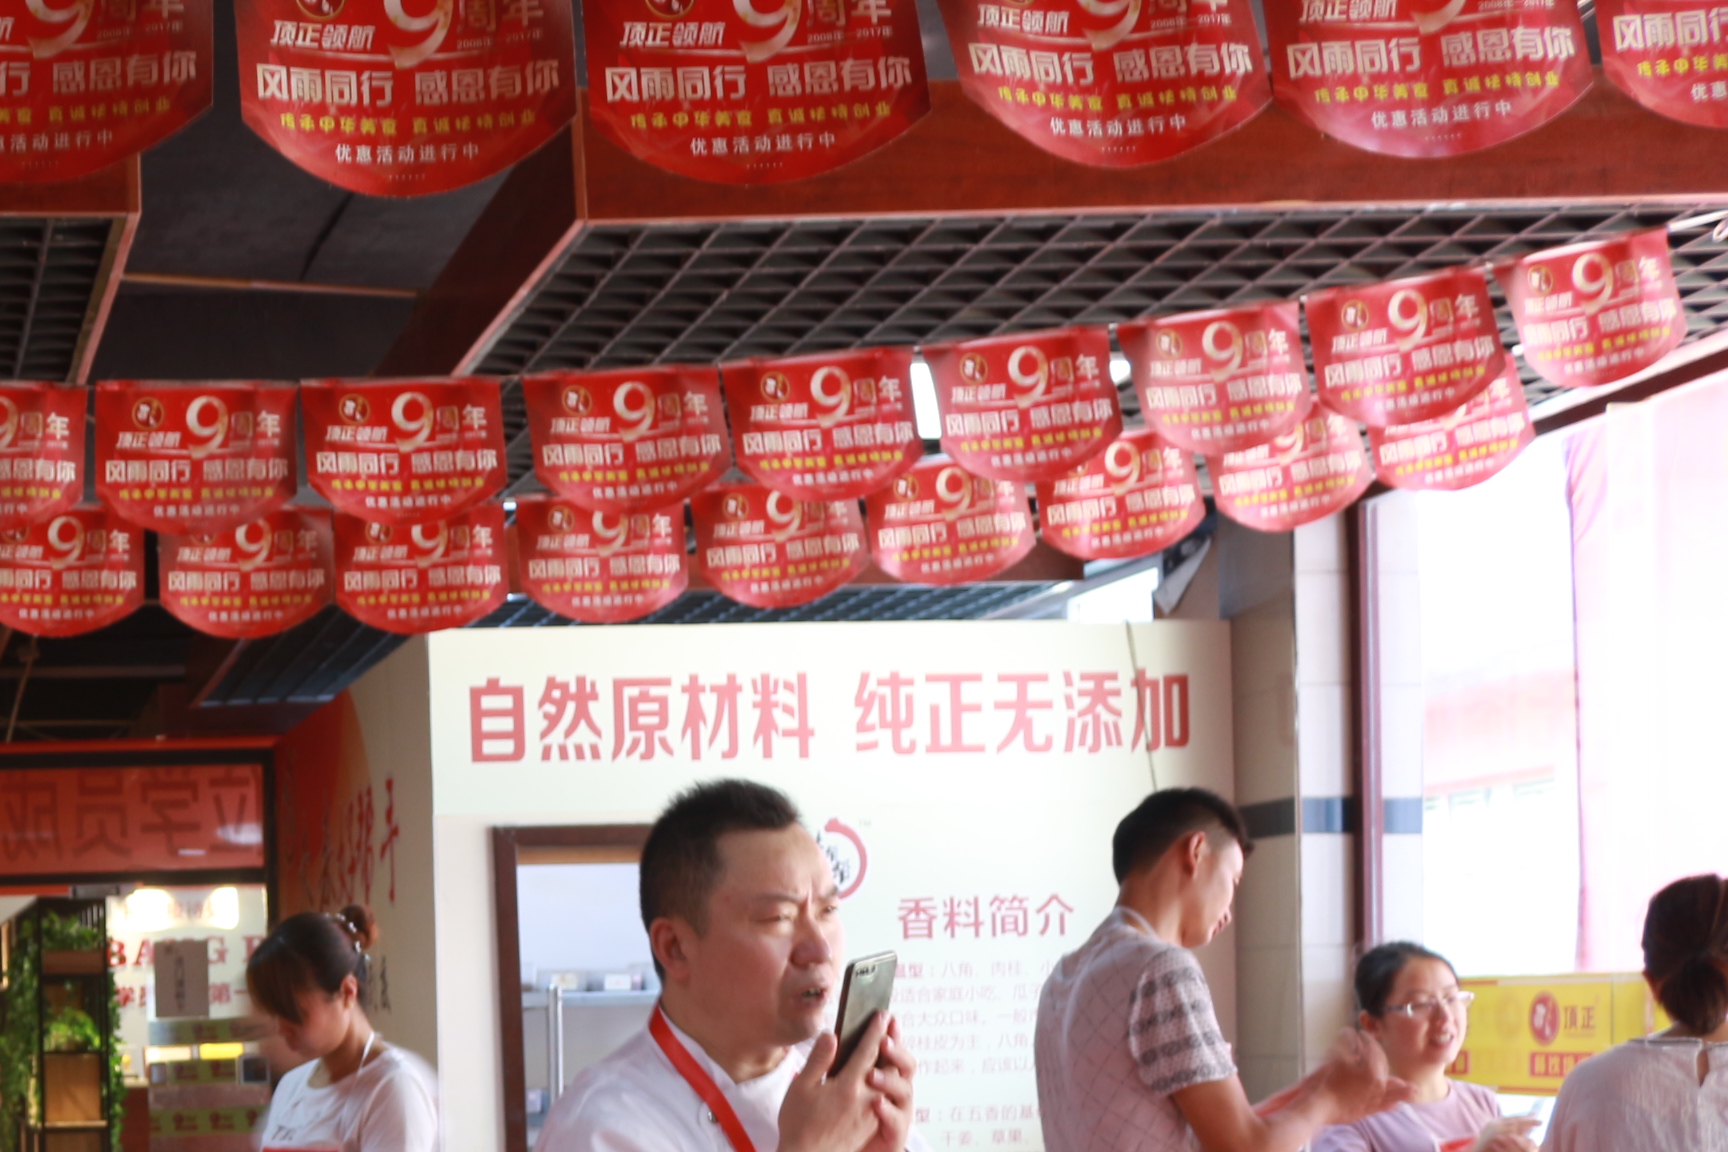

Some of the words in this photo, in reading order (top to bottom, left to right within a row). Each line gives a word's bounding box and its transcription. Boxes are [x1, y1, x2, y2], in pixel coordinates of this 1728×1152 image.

[968, 42, 1094, 86] 风雨同行
[1112, 40, 1250, 82] 感恩有你
[1287, 36, 1421, 79] 风雨同行
[1440, 26, 1575, 67] 感恩有你
[52, 52, 197, 92] 感恩有你
[256, 63, 394, 107] 风雨同行
[414, 60, 560, 105] 感恩有你
[605, 65, 747, 102] 风雨同行
[768, 55, 912, 97] 感恩有你
[1049, 113, 1187, 136] 优惠活动进行中
[1371, 99, 1512, 128] 优惠活动进行中
[334, 142, 479, 163] 优惠活动进行中
[690, 133, 836, 155] 优惠活动进行中
[1523, 319, 1587, 342] 风雨同行
[1599, 300, 1677, 332] 感恩有你
[1326, 351, 1402, 386] 风雨同行
[1413, 337, 1494, 370] 感恩有你
[1146, 383, 1217, 409] 风雨同行
[1226, 374, 1302, 402] 感恩有你
[946, 410, 1020, 438] 风雨同行
[1030, 400, 1112, 428] 感恩有你
[543, 444, 624, 465] 风雨同行
[636, 435, 721, 462] 感恩有你
[744, 428, 823, 456] 风雨同行
[833, 421, 914, 449] 感恩有你
[106, 459, 191, 484] 风雨同行
[202, 457, 289, 483] 感恩有你
[316, 452, 400, 476] 风雨同行
[411, 449, 498, 475] 感恩有你
[469, 674, 815, 762] 自然原材料
[854, 668, 1190, 755] 纯正无添加
[898, 894, 1074, 940] 香料简介
